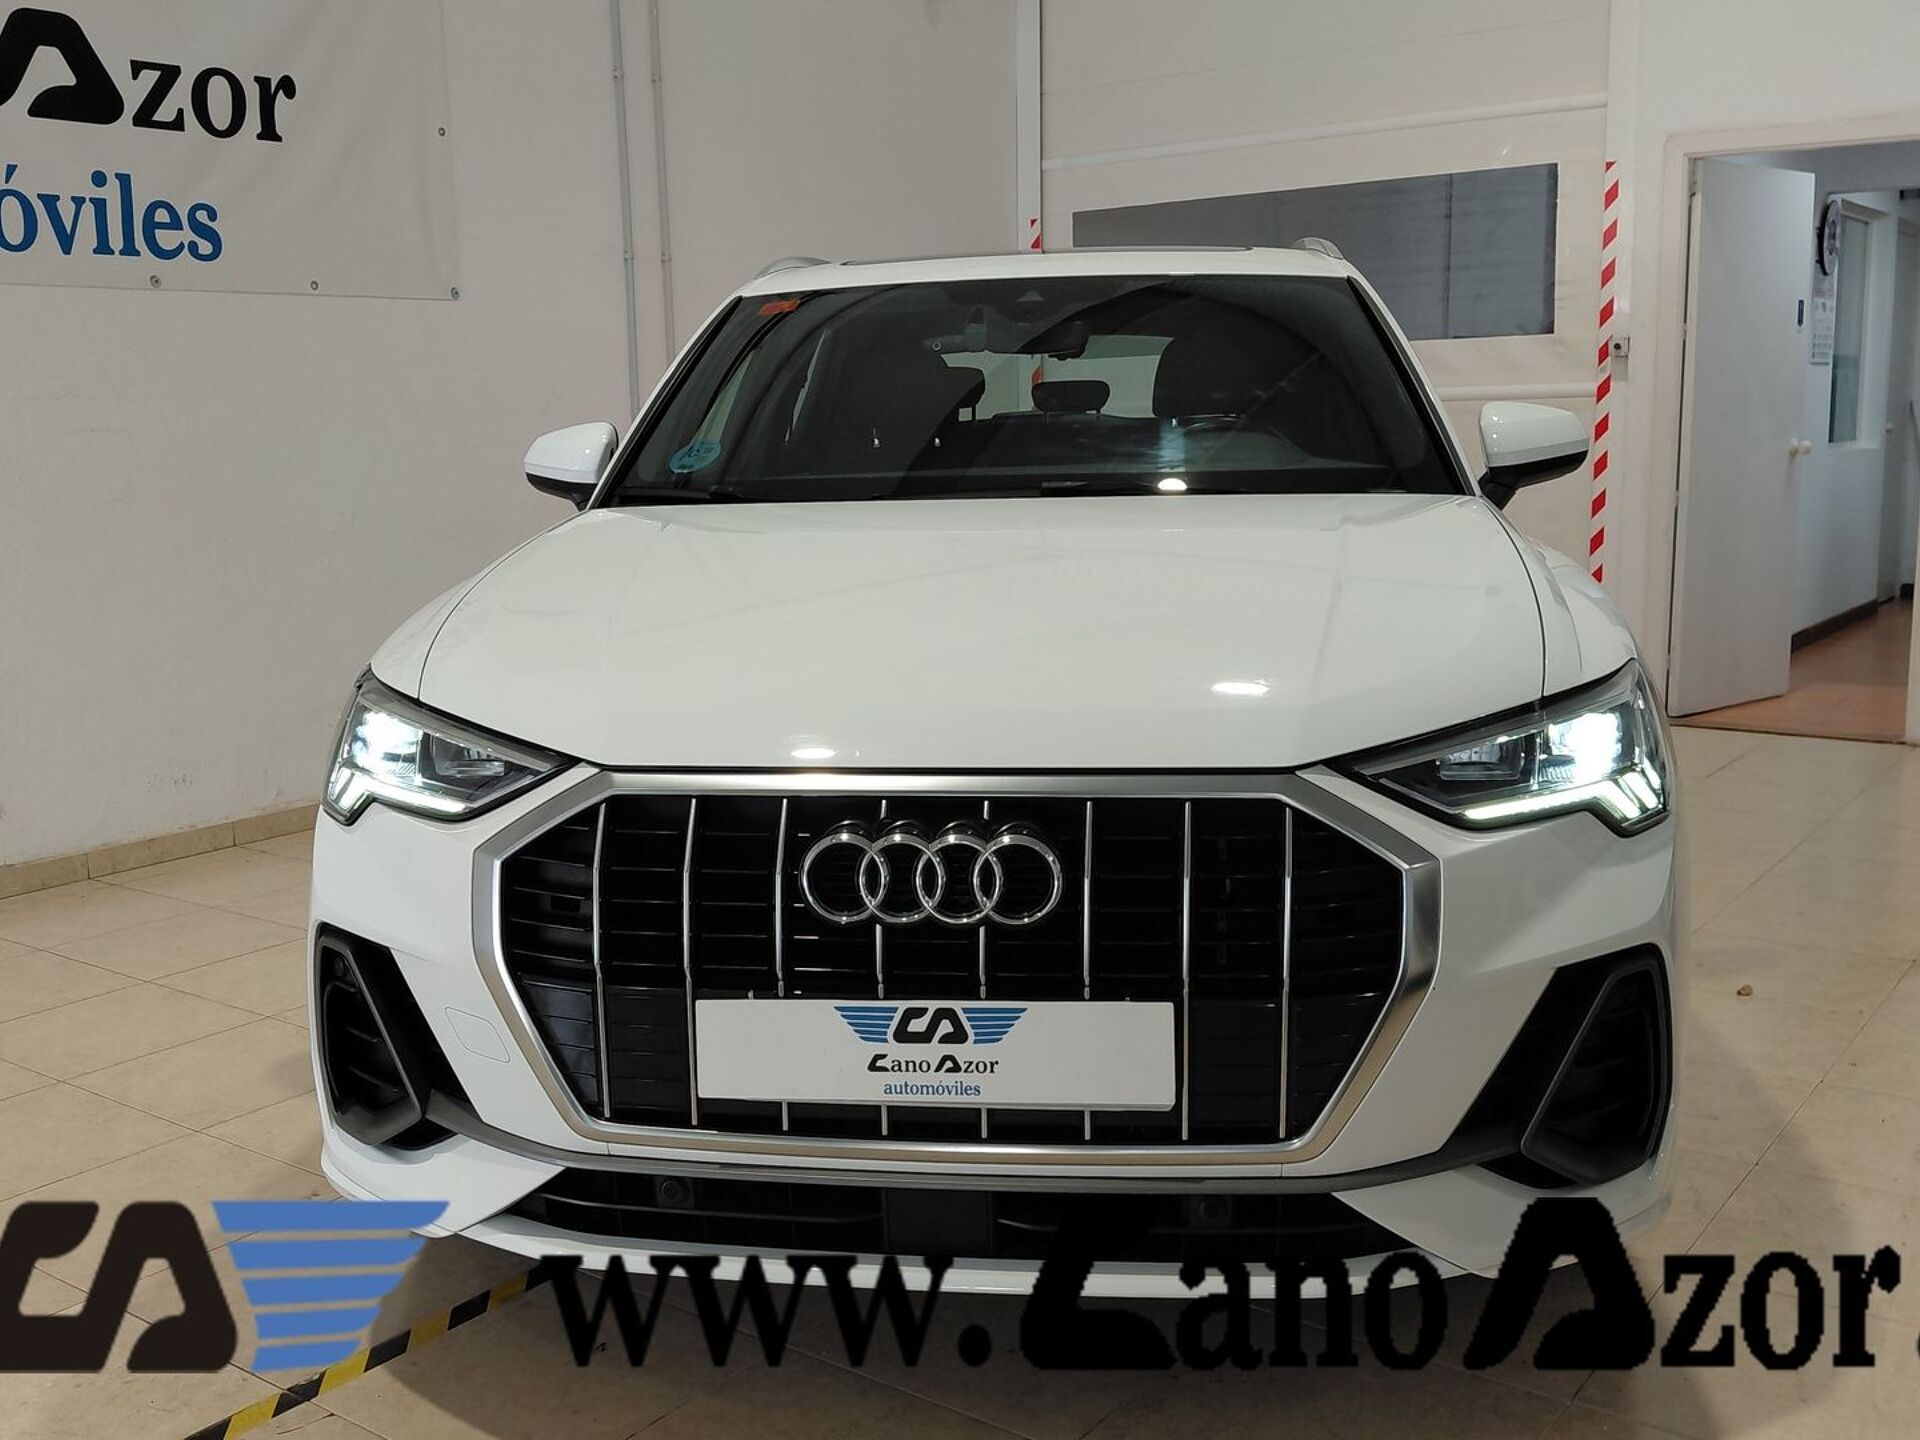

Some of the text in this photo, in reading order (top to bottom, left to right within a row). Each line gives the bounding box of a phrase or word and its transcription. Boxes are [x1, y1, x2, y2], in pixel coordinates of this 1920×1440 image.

[0, 8, 296, 142] Azor
[867, 1053, 999, 1074] Cano Azor
[884, 1081, 981, 1096] automóviles
